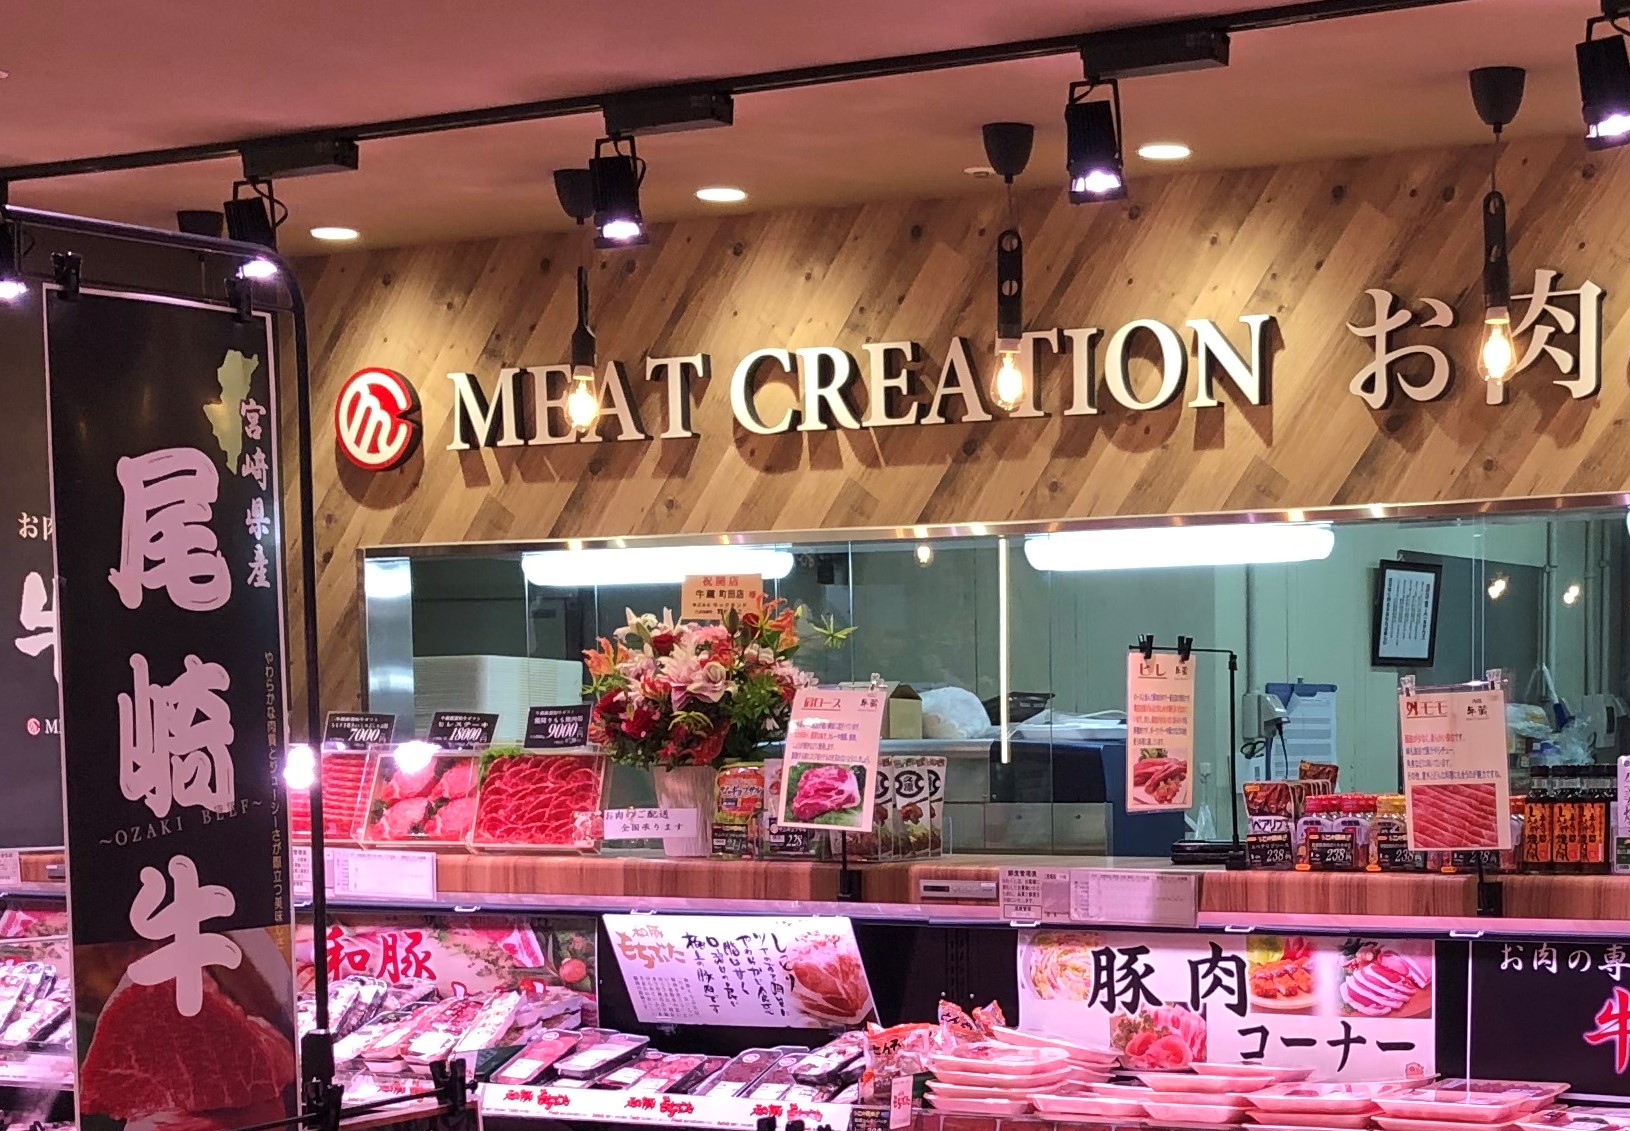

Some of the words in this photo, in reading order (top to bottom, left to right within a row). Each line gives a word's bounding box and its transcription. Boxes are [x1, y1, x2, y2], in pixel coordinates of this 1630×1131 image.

[445, 352, 703, 452] MEAT
[730, 314, 1273, 434] CREATION
[1406, 701, 1448, 716] 外モモ
[327, 927, 437, 982] 和豚
[1089, 942, 1249, 1018] 豚肉
[1237, 1020, 1416, 1072] コーナー
